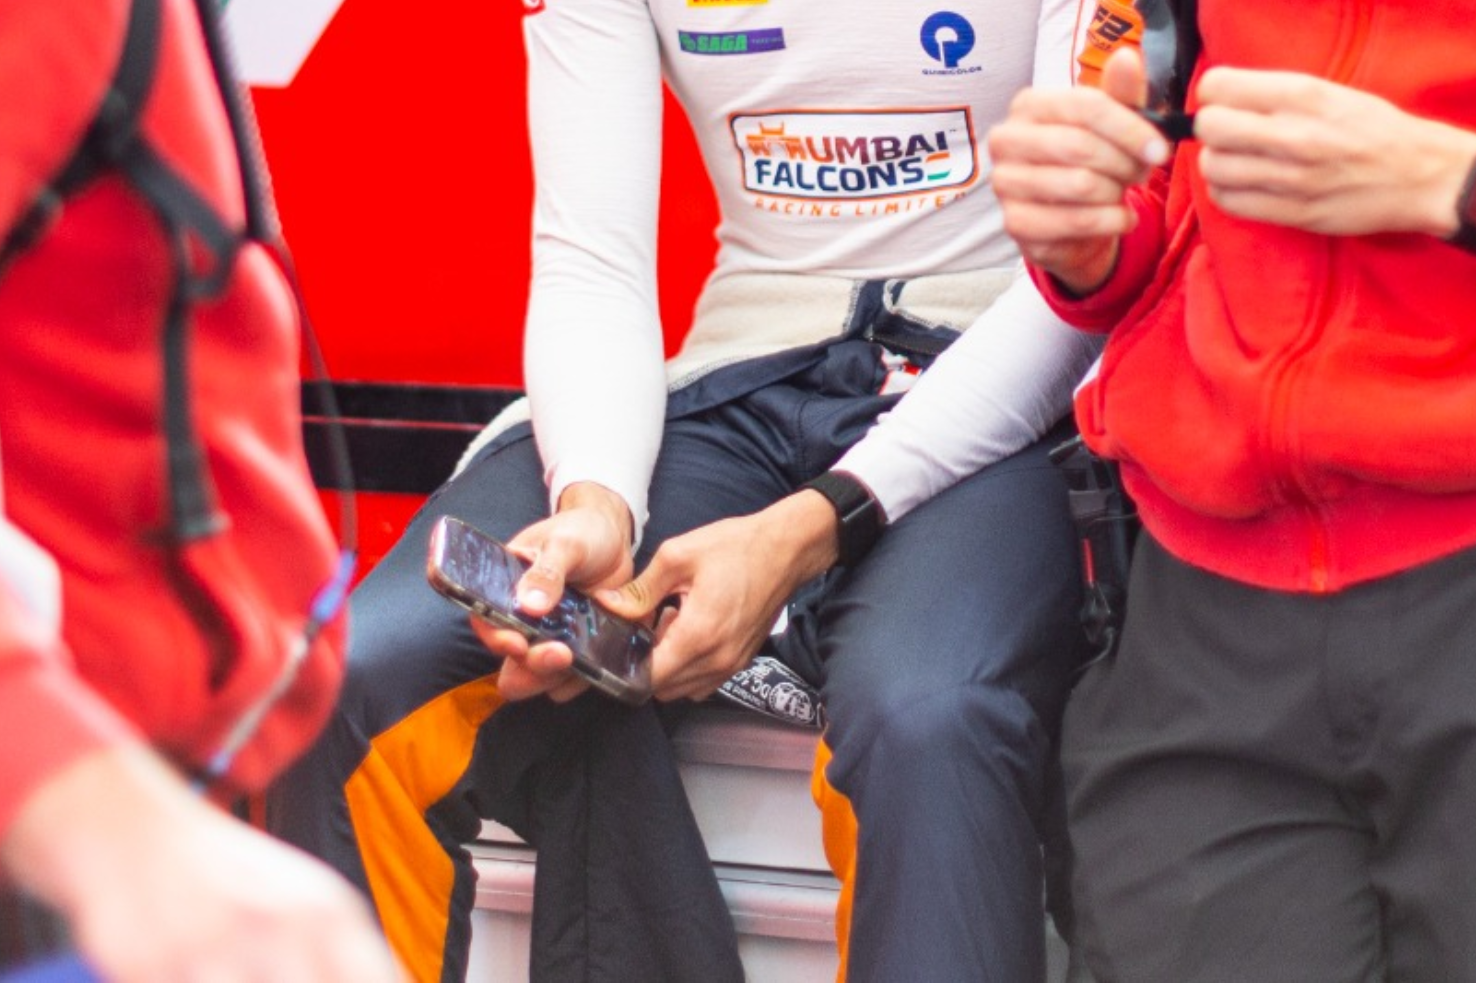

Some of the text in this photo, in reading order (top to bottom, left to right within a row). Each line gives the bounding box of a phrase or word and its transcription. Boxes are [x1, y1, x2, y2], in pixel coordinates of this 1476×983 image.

[696, 34, 748, 52] SAGA
[745, 124, 949, 166] MUMBAI
[754, 156, 924, 192] FALCONS
[754, 197, 842, 217] RACING
